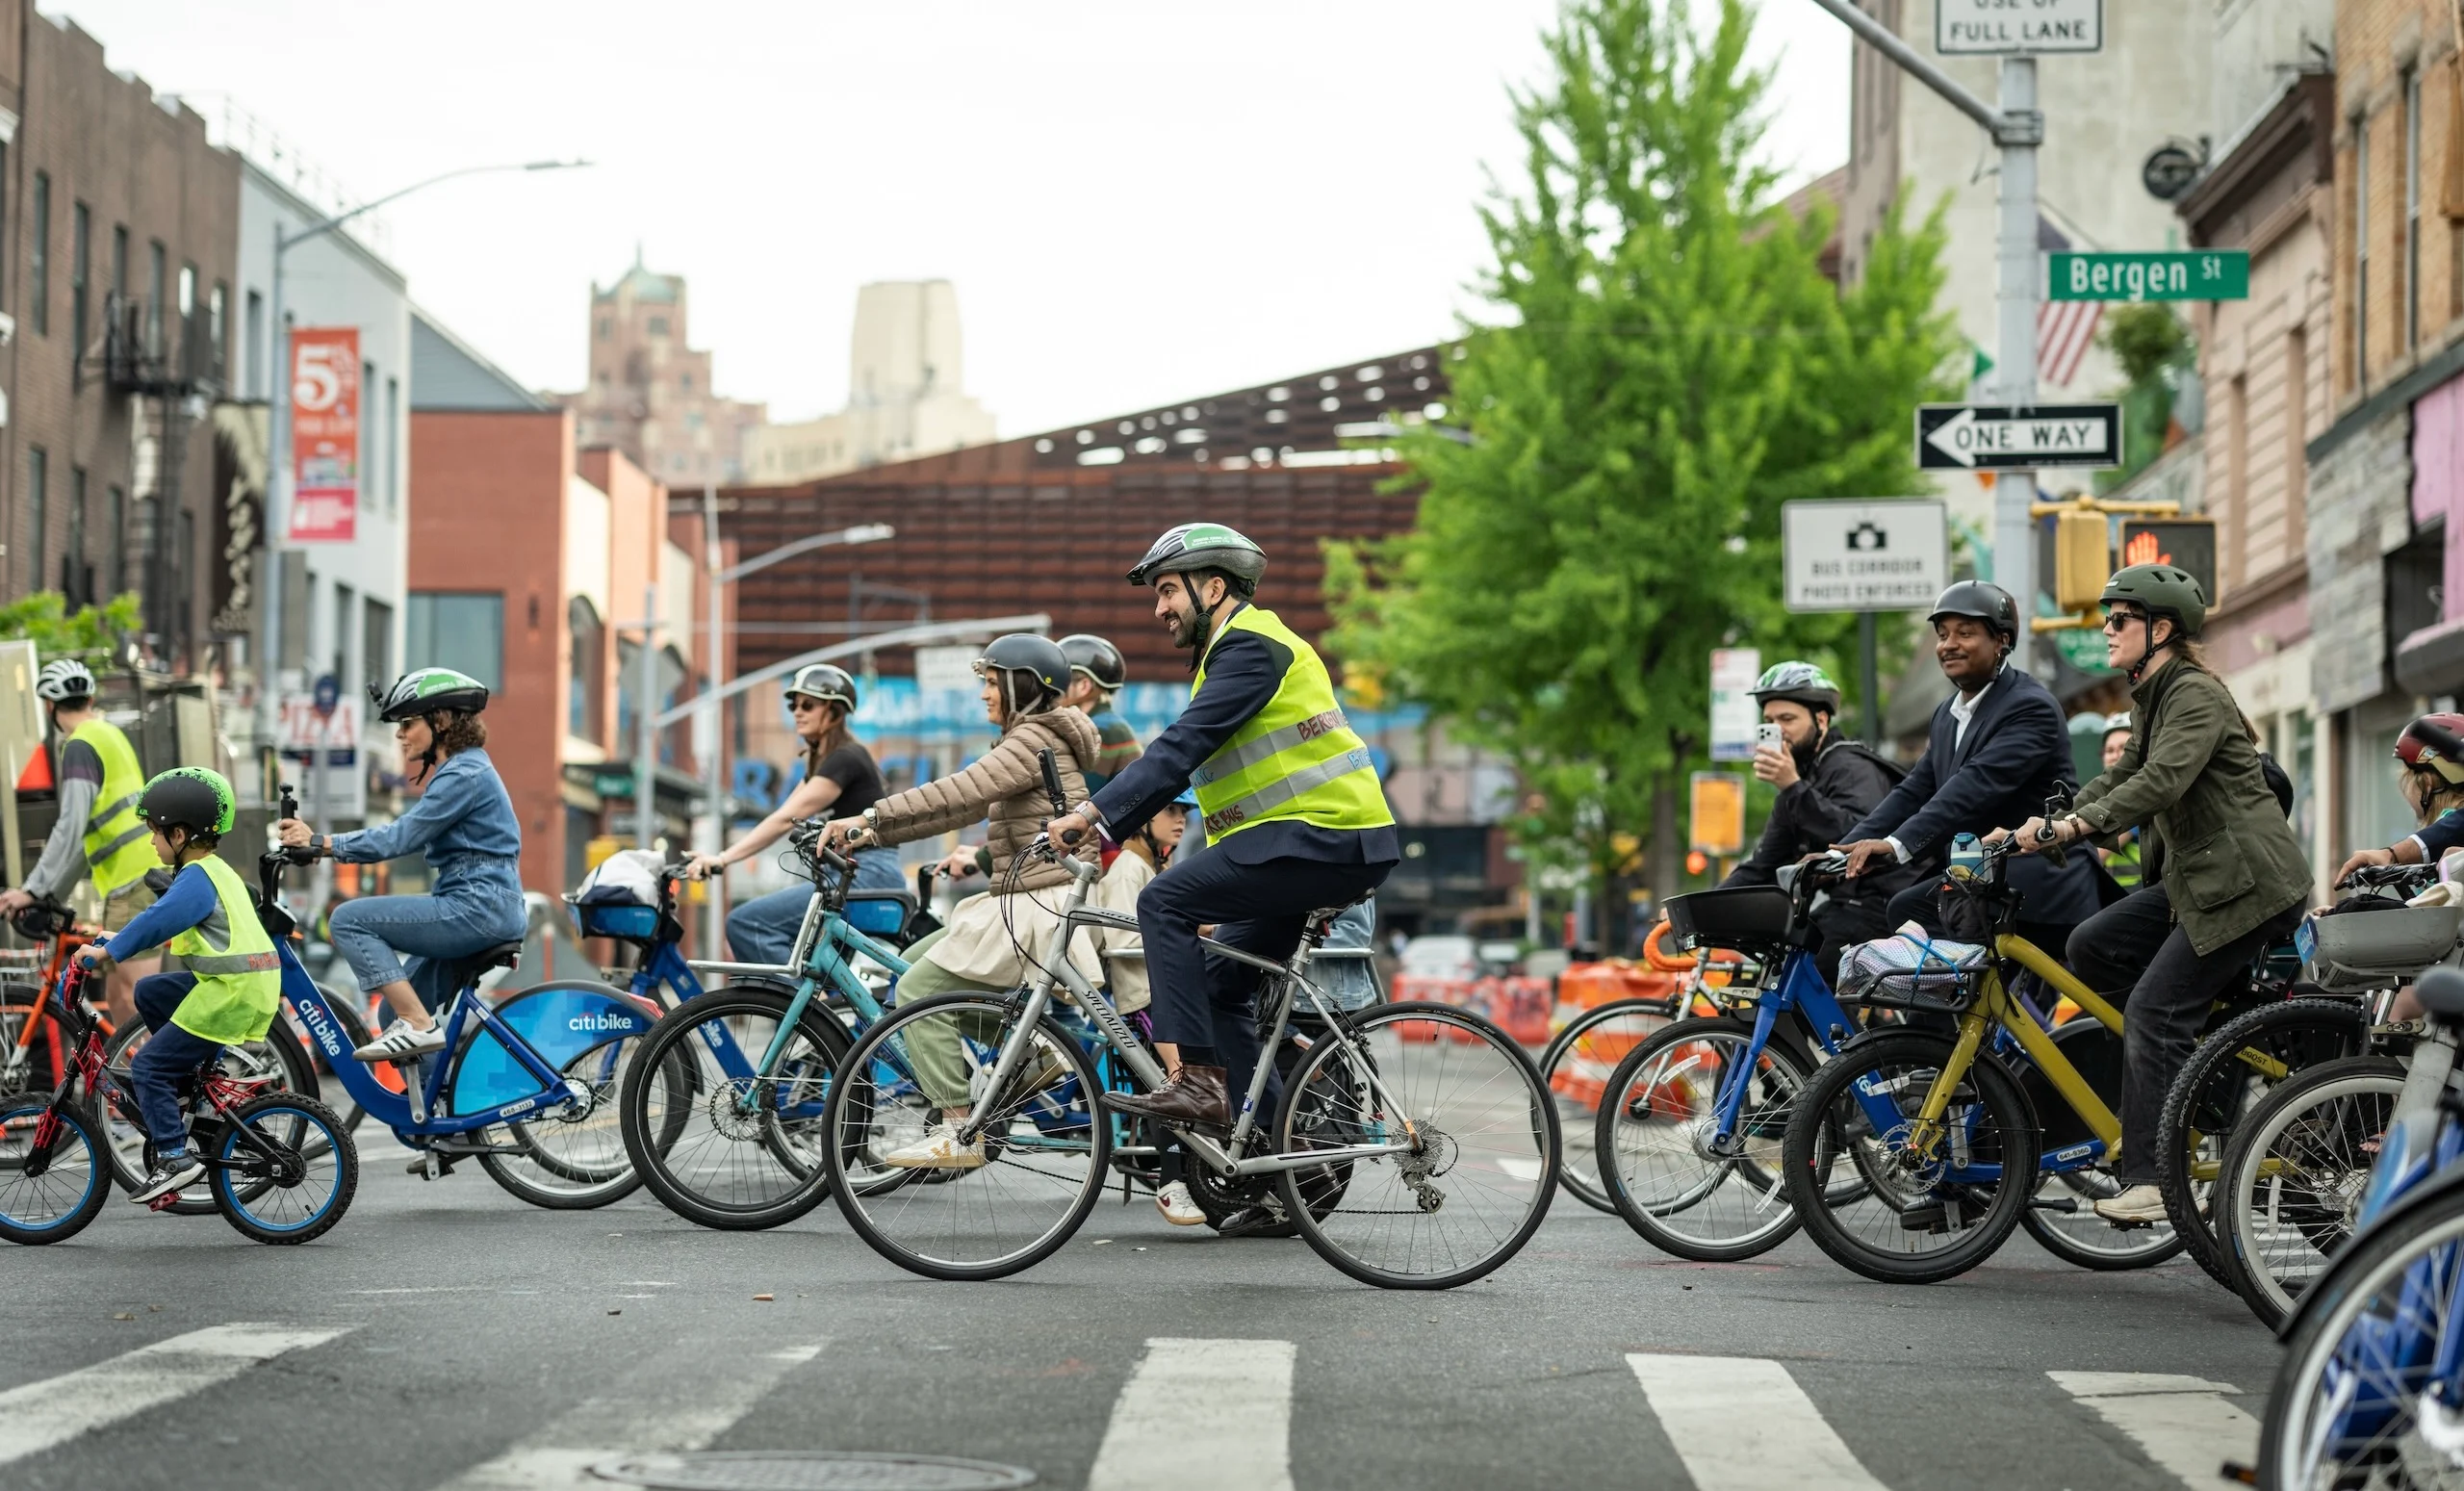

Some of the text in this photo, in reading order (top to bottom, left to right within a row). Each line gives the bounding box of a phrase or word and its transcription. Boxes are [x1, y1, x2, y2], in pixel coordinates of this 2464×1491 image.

[1950, 20, 2088, 41] FULL LANE
[2070, 256, 2223, 302] Bergen St
[1955, 424, 2092, 450] ONE WAY
[1811, 558, 1923, 576] BUS CORRIDOR
[1802, 579, 1935, 598] PHOTO ENFORCED
[298, 998, 341, 1057] citi bike
[569, 1012, 632, 1031] citi bike
[1081, 990, 1138, 1050] SPECIALIZED
